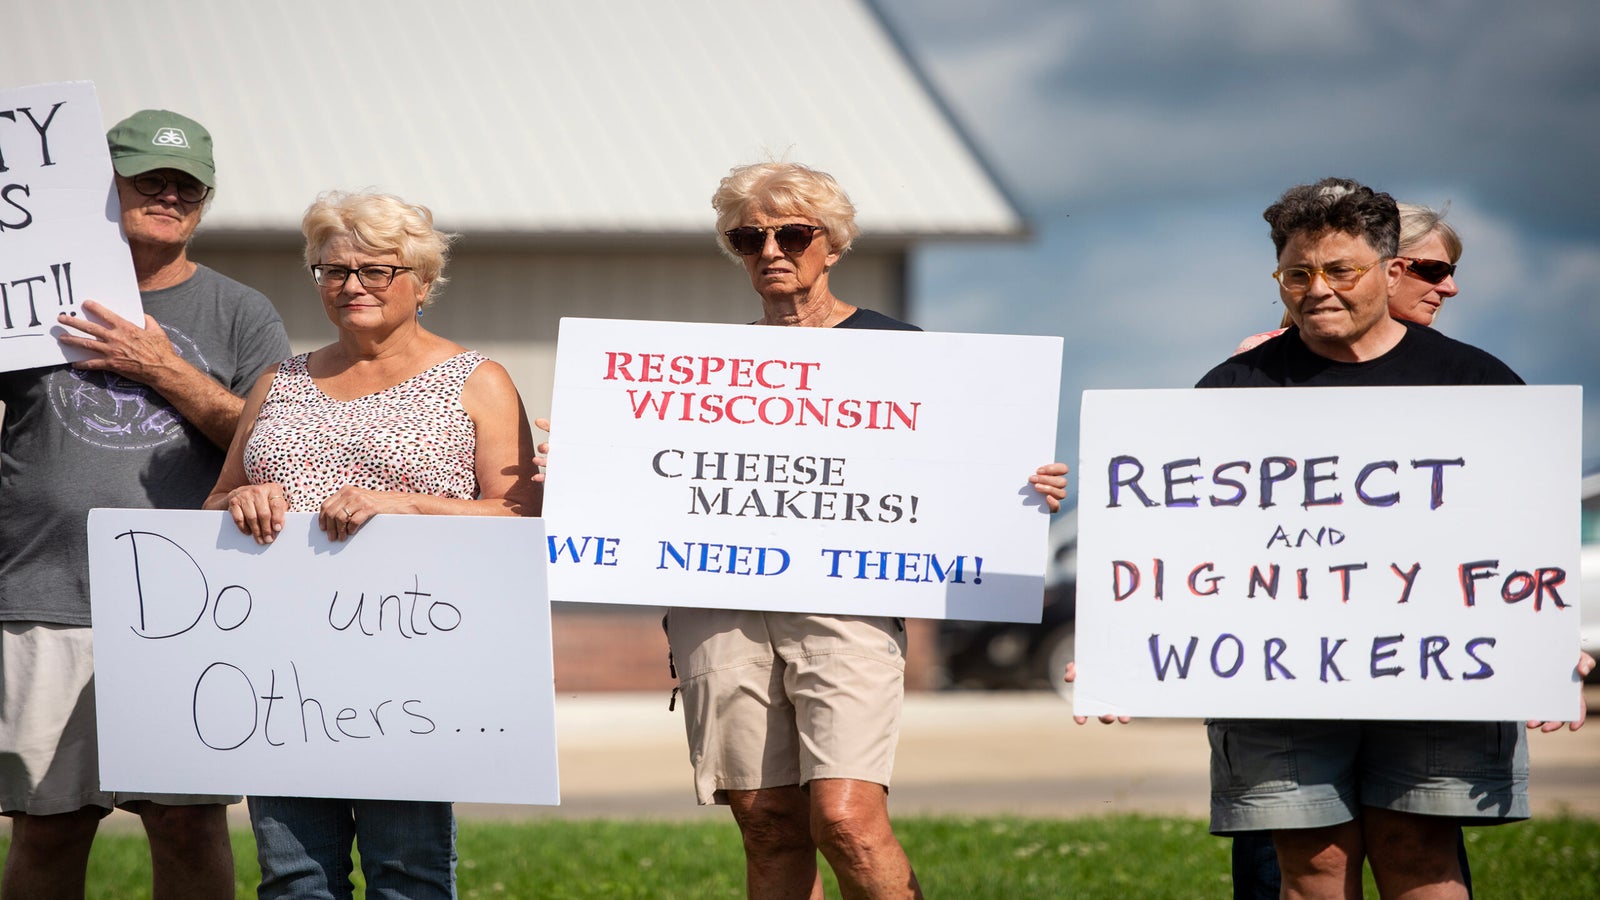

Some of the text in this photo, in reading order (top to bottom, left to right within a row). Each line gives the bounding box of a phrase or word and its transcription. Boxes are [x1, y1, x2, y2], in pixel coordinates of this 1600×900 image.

[603, 351, 821, 391] RESPECT
[626, 389, 922, 432] WISCONSIN
[652, 449, 847, 487] CHEESE
[1106, 455, 1466, 511] RESPECT
[688, 486, 919, 524] MAKERS!
[546, 535, 985, 585] WE NEED THEM!
[1266, 525, 1346, 549] AND
[115, 529, 462, 639] Do unto
[1112, 558, 1572, 612] DIGNITY FOR
[1148, 633, 1497, 683] WORKERS
[193, 660, 506, 751] Others...
